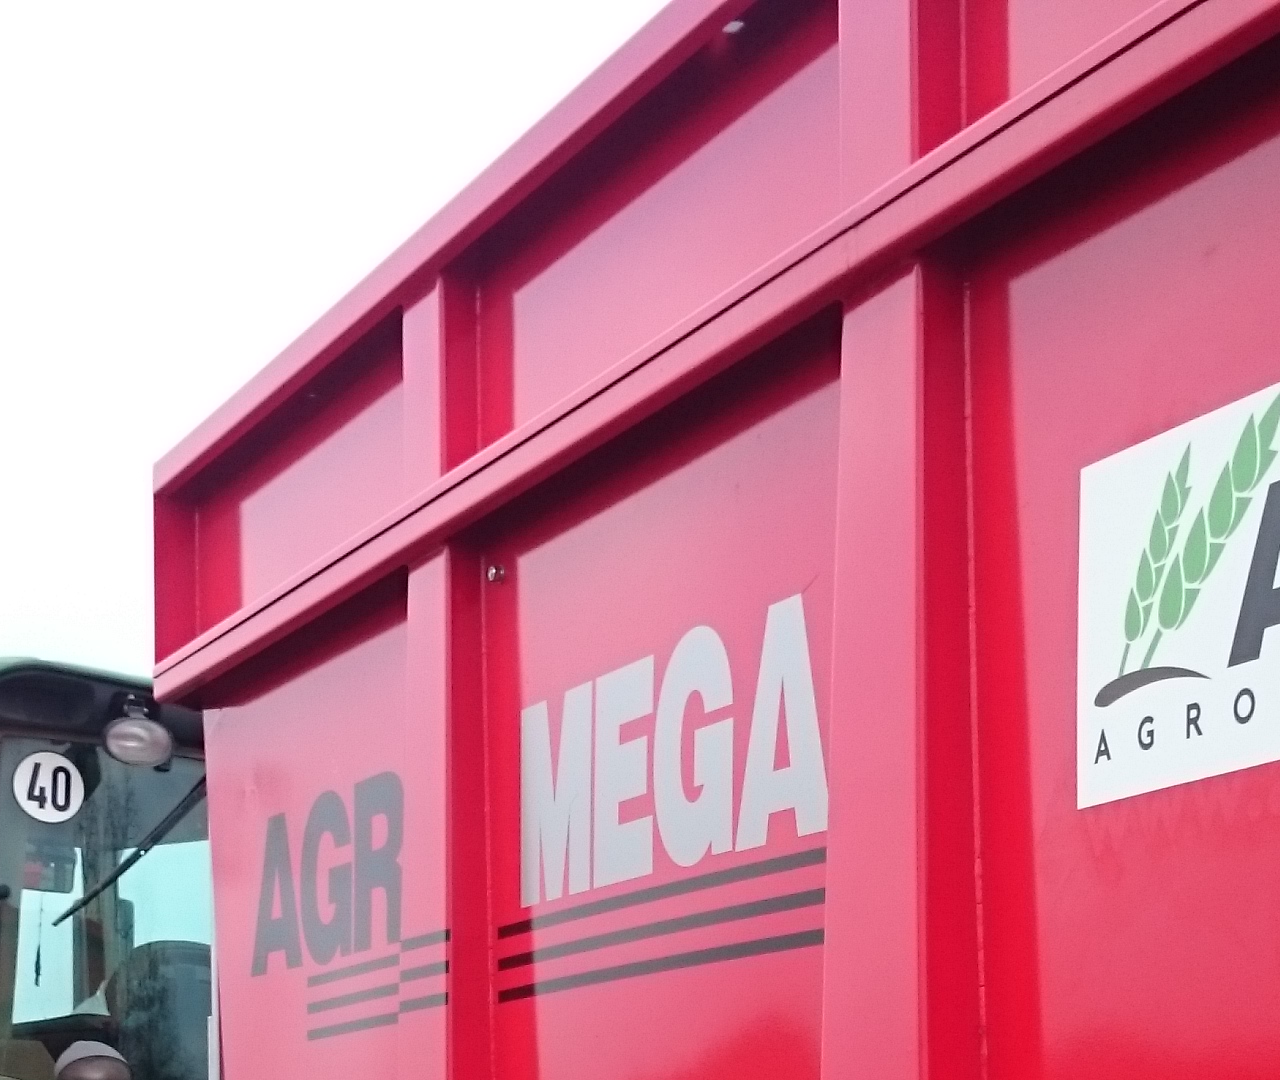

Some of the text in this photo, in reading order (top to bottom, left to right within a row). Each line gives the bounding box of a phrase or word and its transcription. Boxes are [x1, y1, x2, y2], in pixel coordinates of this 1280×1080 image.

[26, 761, 72, 812] 40
[251, 593, 829, 977] AGR MEGA
